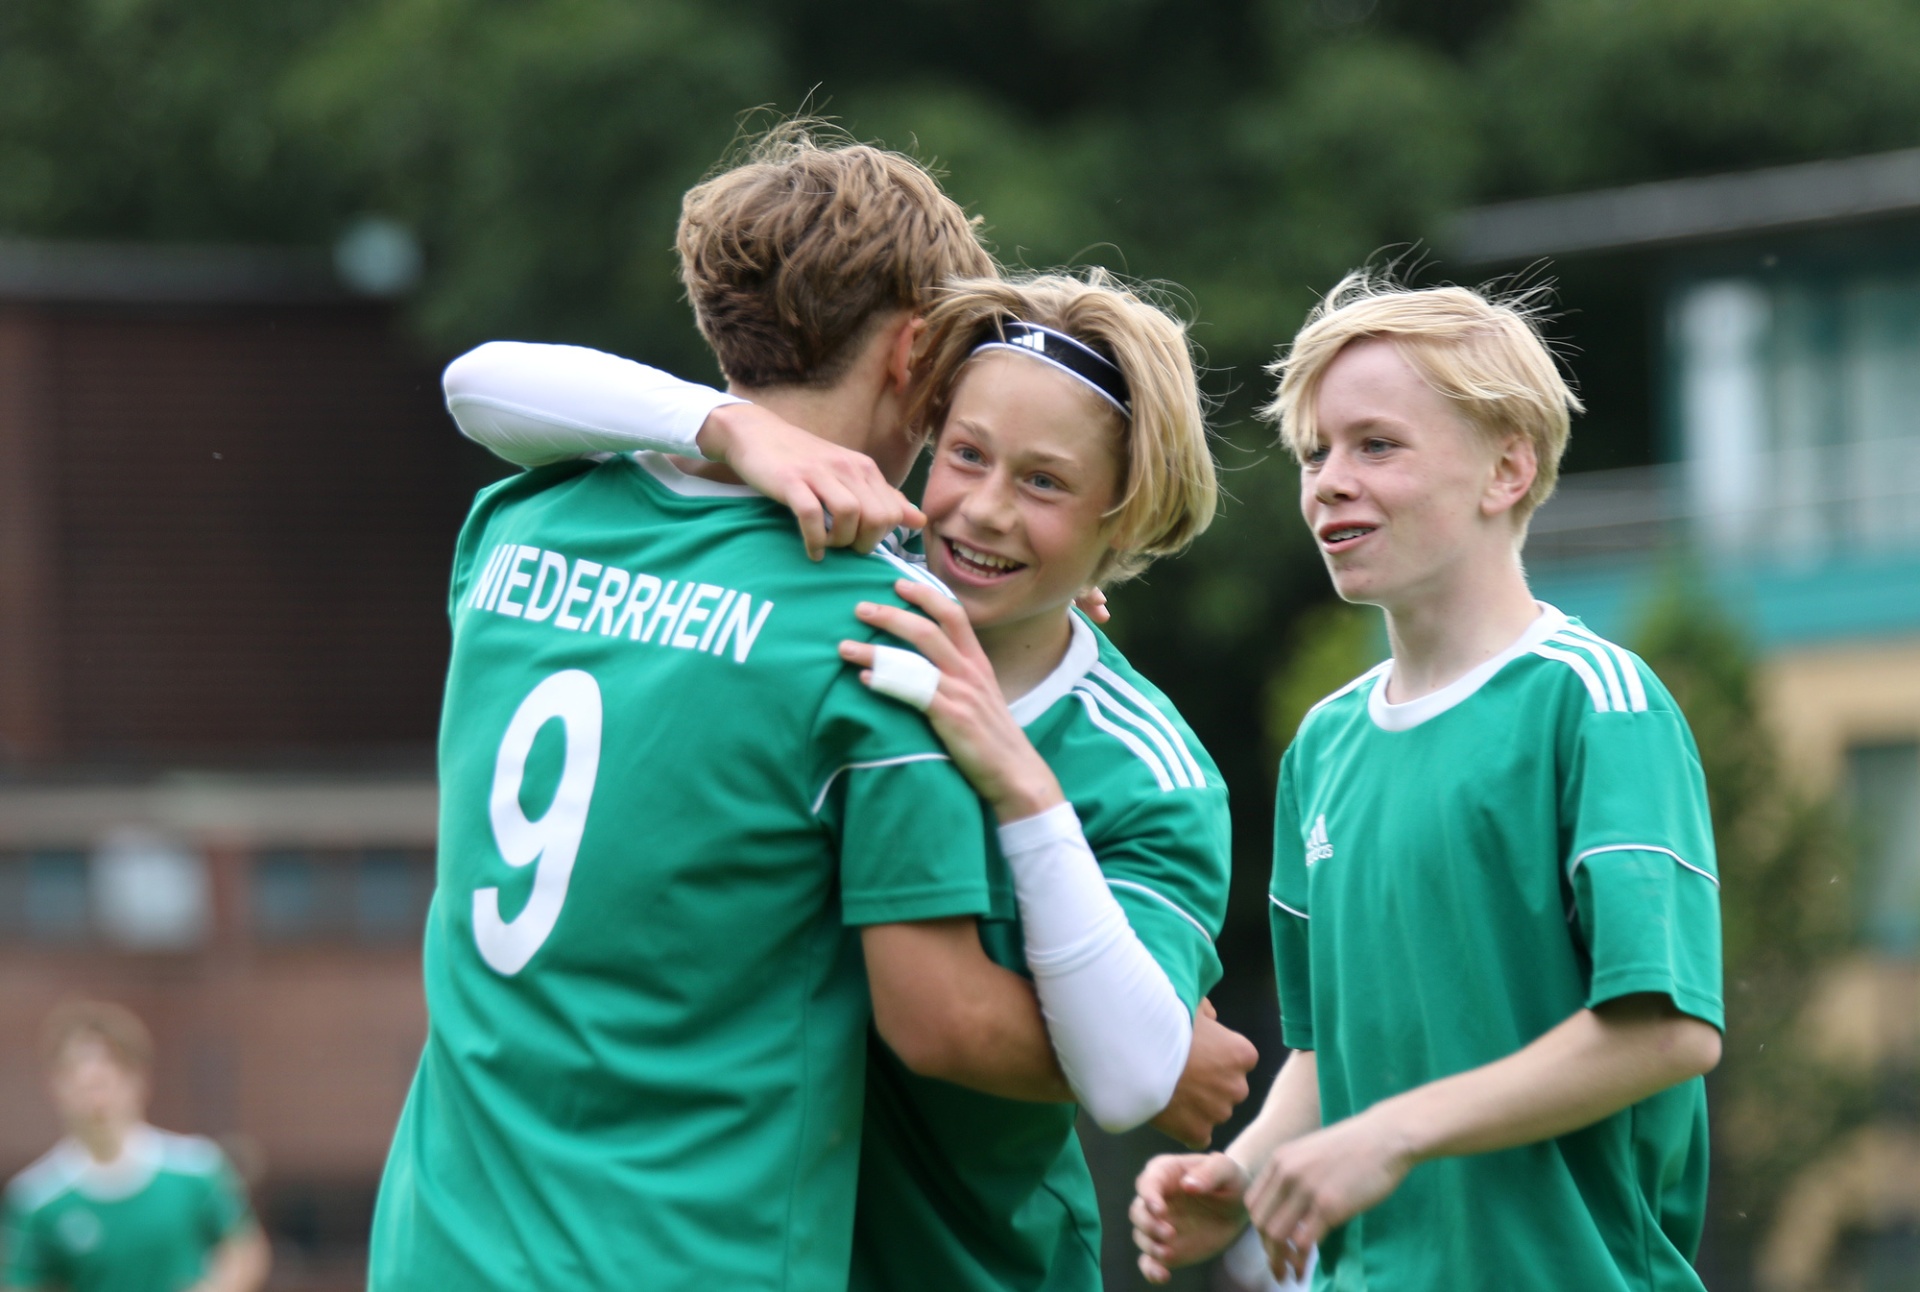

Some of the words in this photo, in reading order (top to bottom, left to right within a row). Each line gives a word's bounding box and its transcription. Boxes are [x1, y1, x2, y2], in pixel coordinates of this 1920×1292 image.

[468, 544, 774, 663] NIEDERRHEIN
[472, 669, 602, 976] 9
[1306, 843, 1334, 867] das
